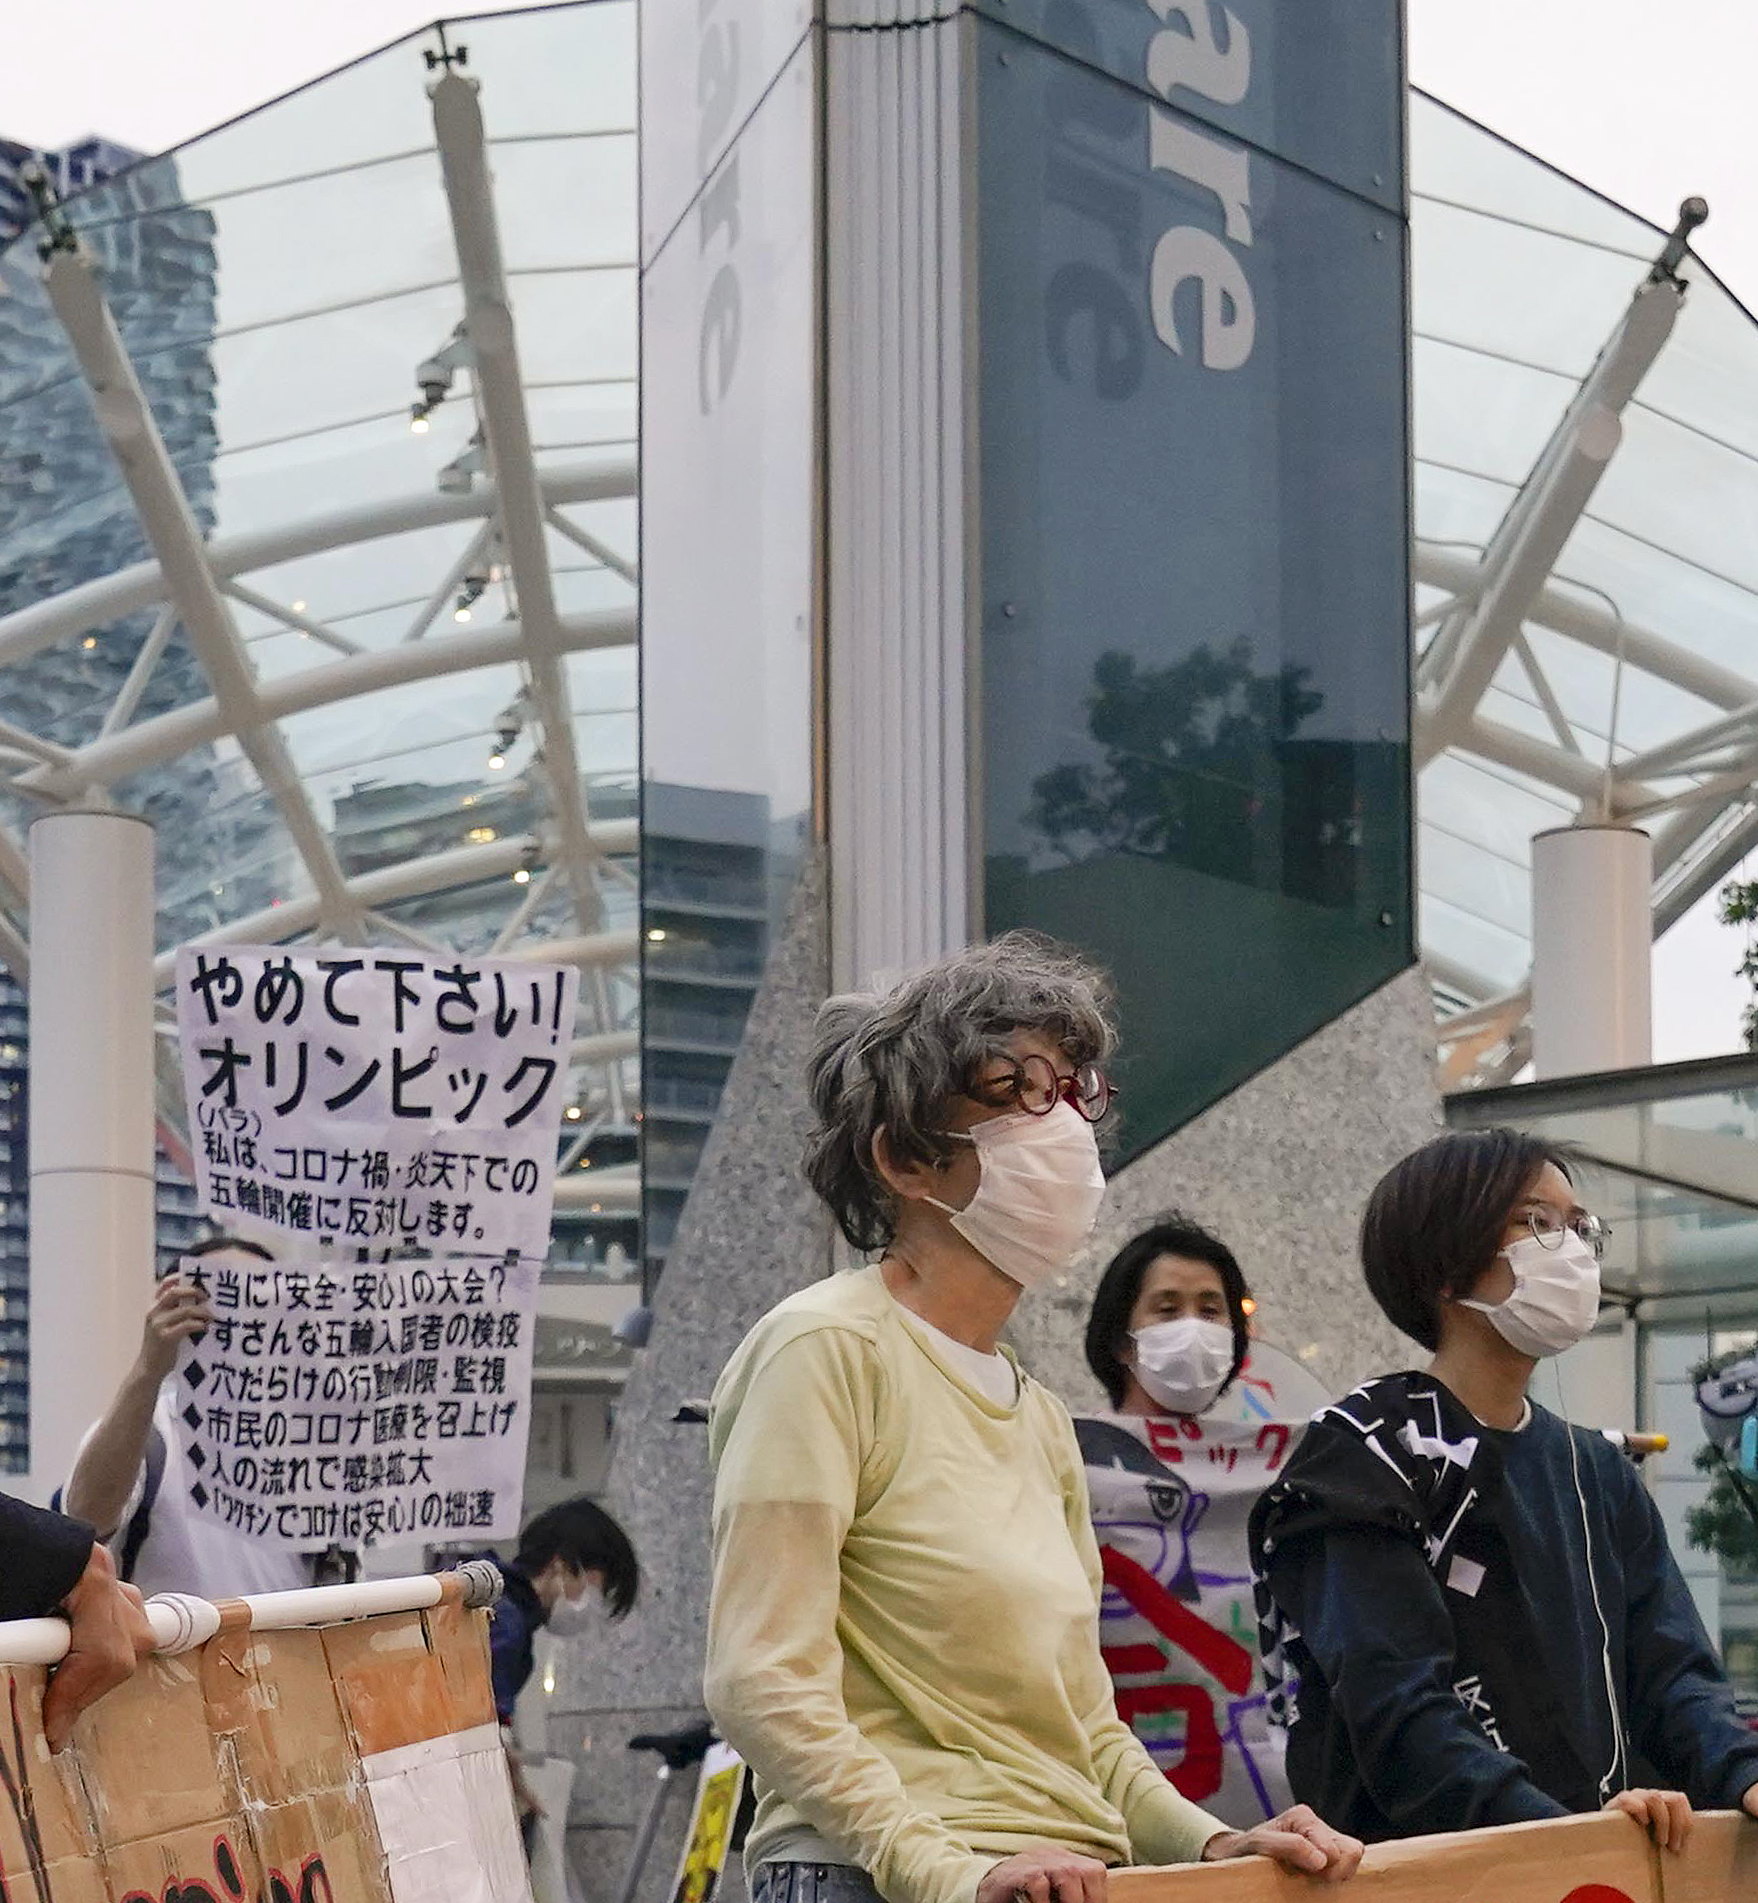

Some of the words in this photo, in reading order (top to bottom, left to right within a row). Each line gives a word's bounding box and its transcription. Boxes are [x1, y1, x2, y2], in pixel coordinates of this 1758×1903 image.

[191, 955, 565, 1045] やめて下さい!
[199, 1037, 557, 1129] オリンピック
